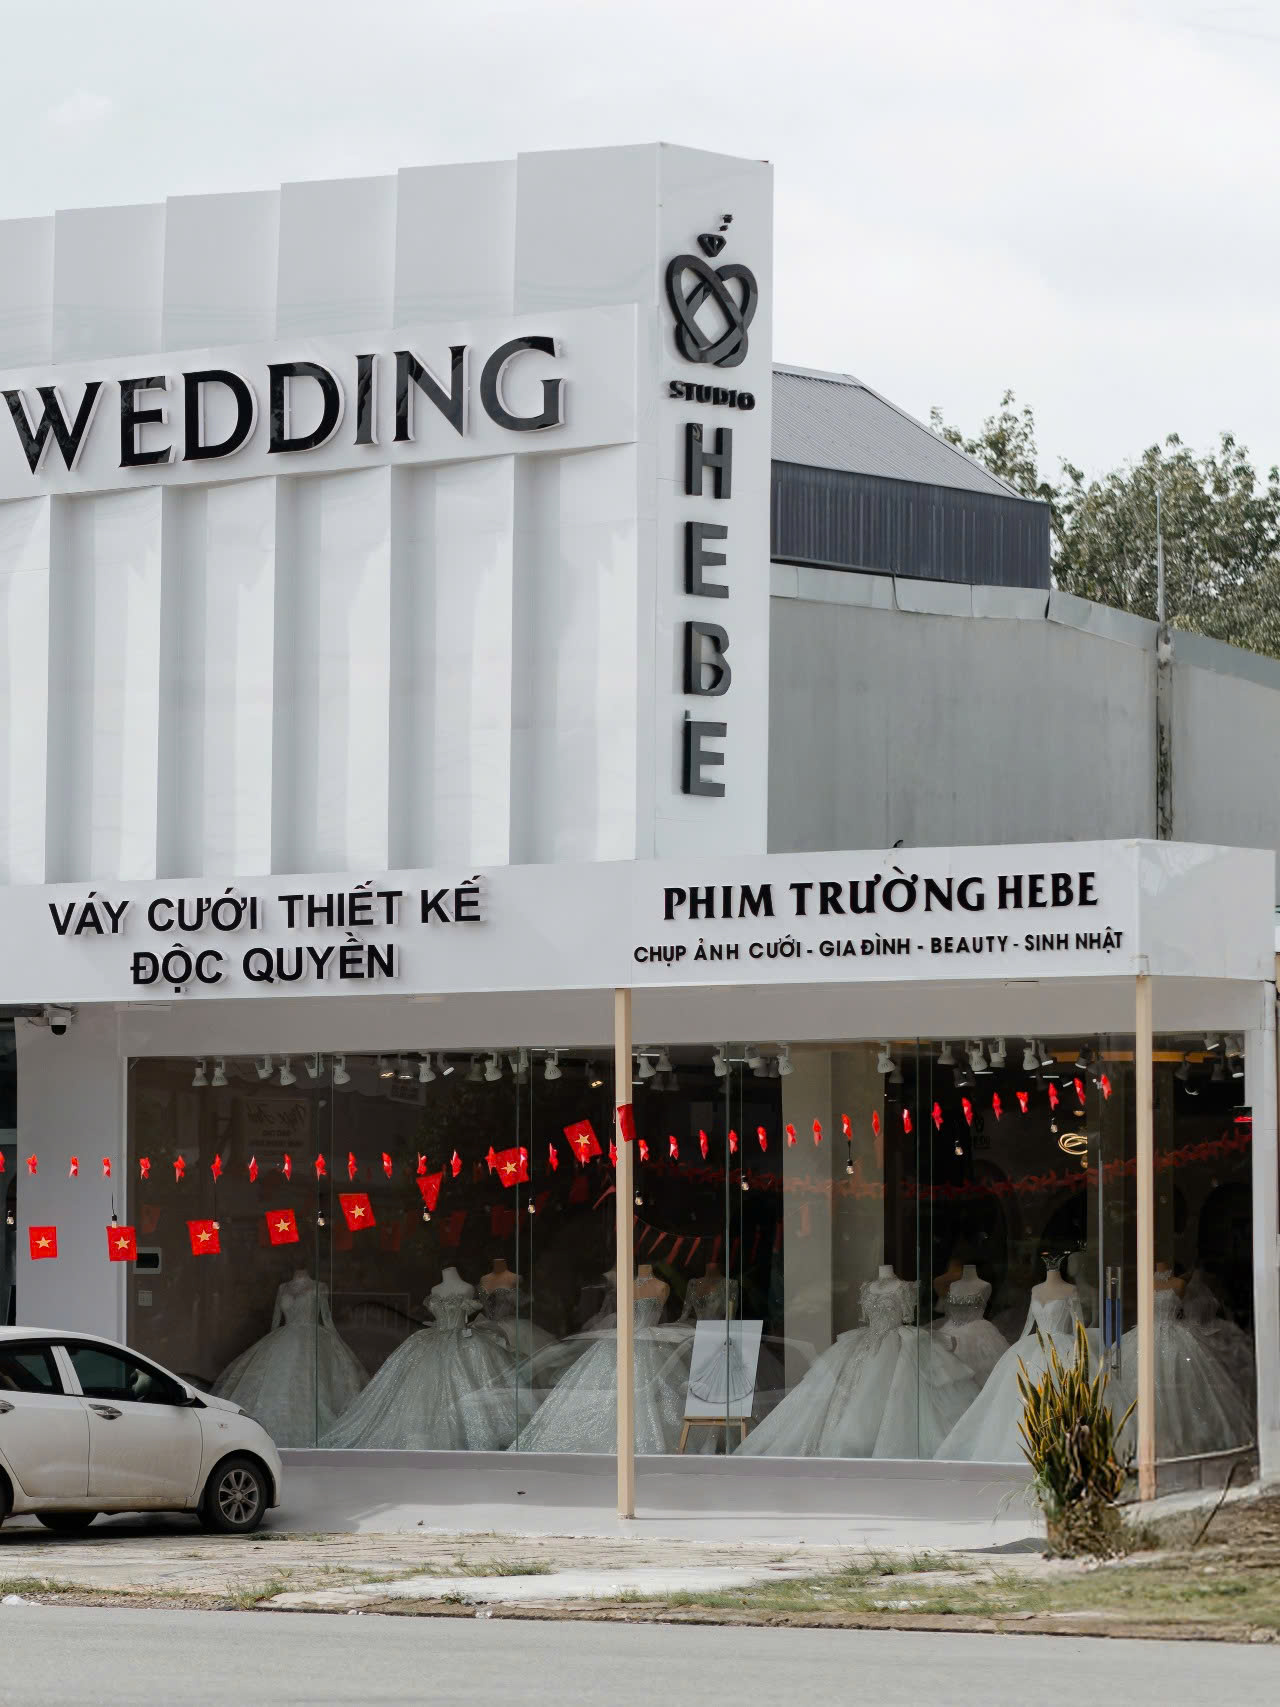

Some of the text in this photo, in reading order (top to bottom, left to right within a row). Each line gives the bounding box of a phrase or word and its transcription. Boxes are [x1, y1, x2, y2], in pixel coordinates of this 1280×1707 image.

[0, 335, 565, 475] WEDDING
[669, 380, 756, 411] STUDIO
[683, 422, 734, 798] HEBE
[48, 874, 483, 936] VÁY CƯỚI THIẾT KẾ
[663, 866, 1100, 921] PHIM TRƯỜNG HEBE
[130, 931, 395, 994] ĐỘC QUYỀN
[633, 943, 687, 968] CHỤP
[693, 937, 740, 961] ẢNH
[749, 934, 802, 960] CƯỚI
[819, 938, 856, 958] GIA
[860, 932, 911, 957] ĐÌNH
[930, 935, 1009, 955] BEAUTY
[1024, 932, 1069, 952] SINH
[1075, 926, 1124, 951] NHẬT
